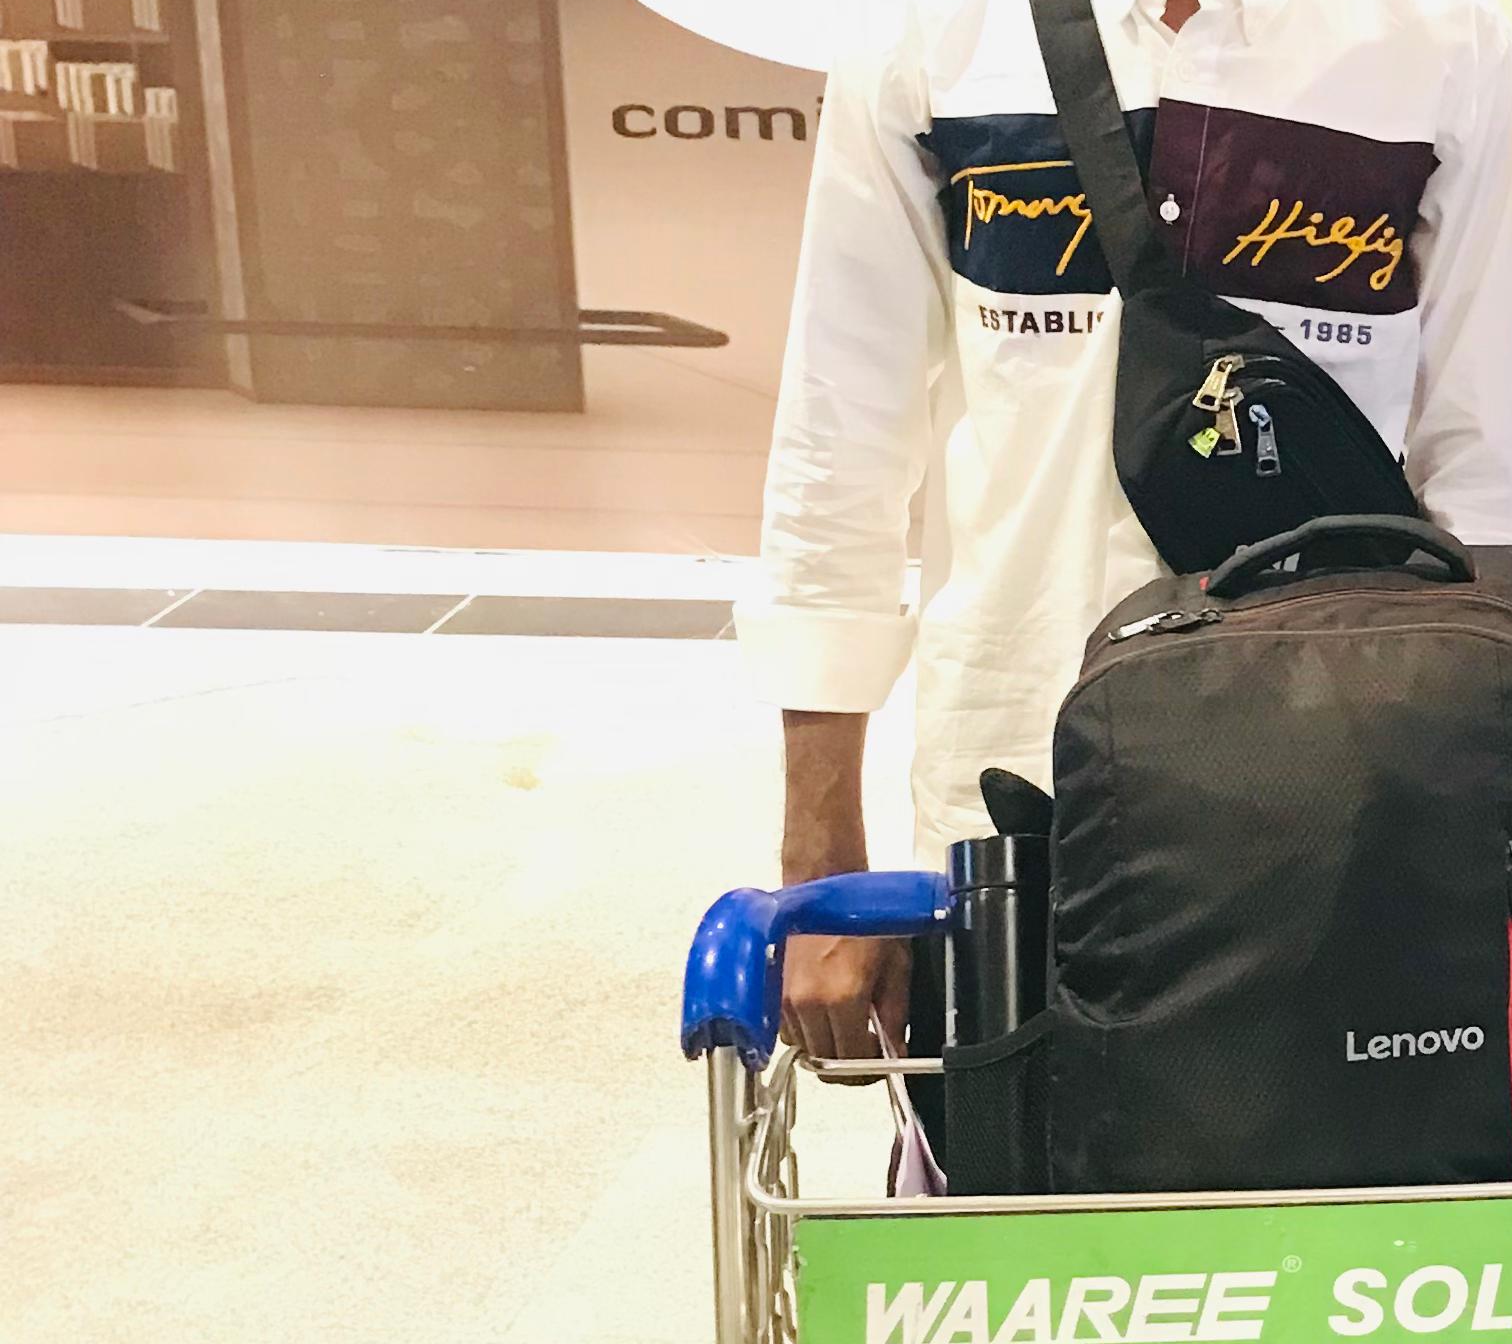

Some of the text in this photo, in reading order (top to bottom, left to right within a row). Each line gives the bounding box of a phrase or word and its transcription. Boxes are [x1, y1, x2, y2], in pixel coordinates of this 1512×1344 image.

[979, 303, 1373, 346] ESTABLI 1985
[1346, 1026, 1485, 1061] Lenovo
